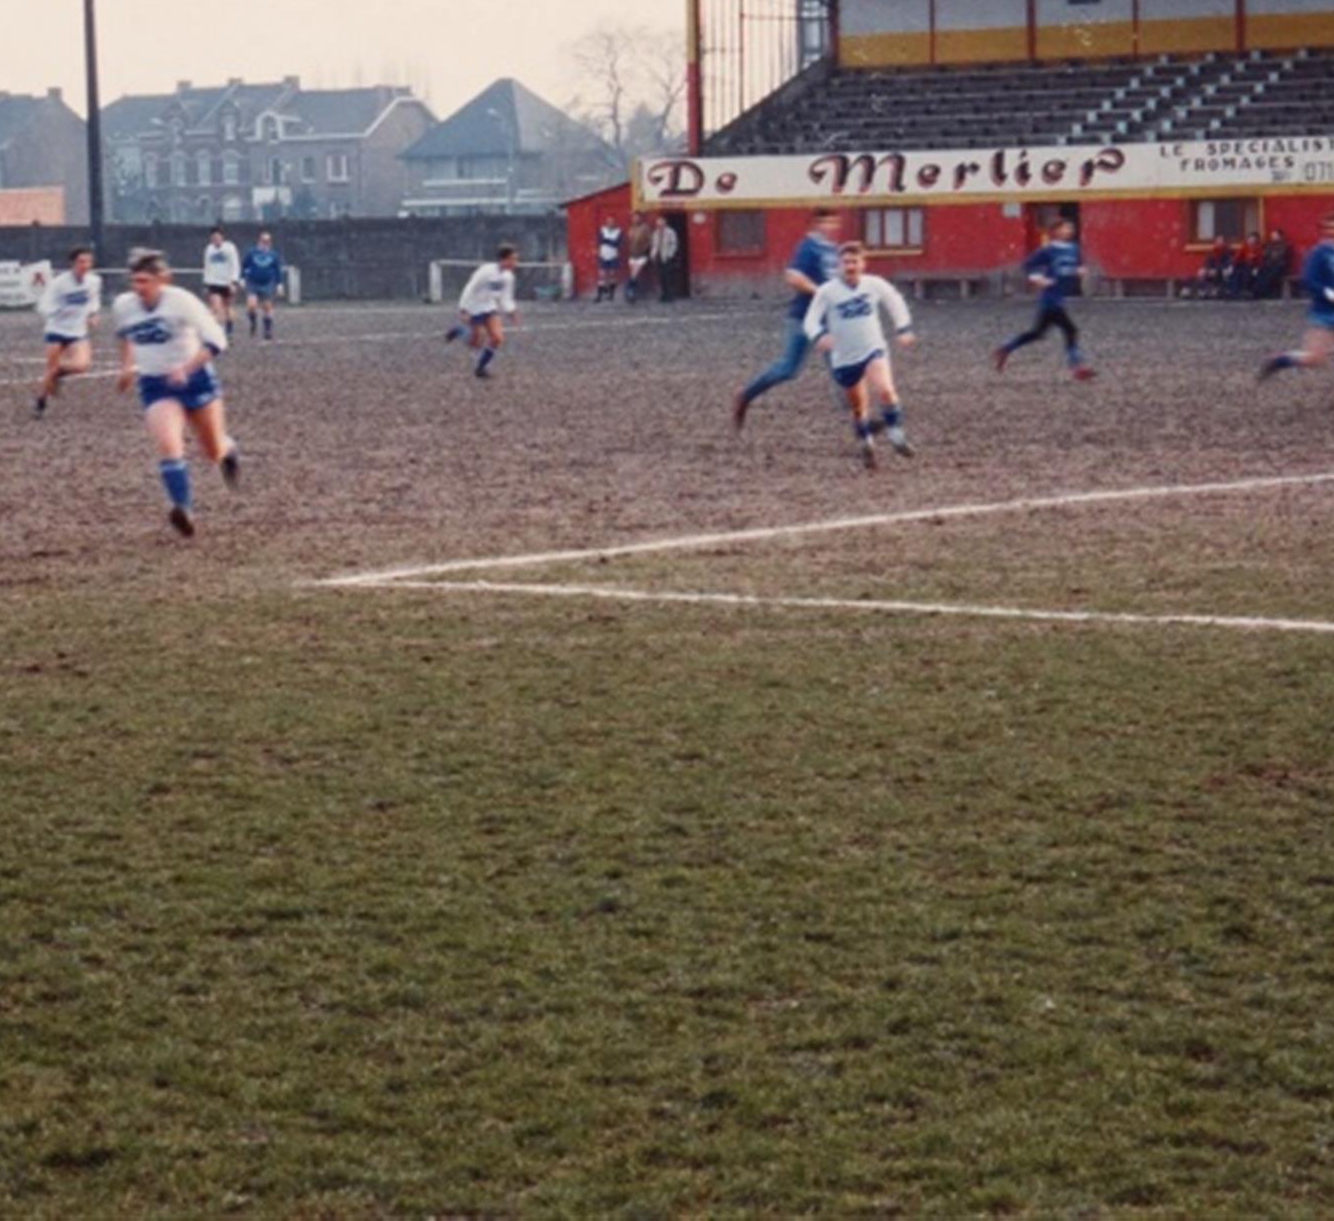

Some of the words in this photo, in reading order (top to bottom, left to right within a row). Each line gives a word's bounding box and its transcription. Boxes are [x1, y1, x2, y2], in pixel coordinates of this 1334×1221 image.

[1159, 144, 1183, 158] LE
[647, 160, 738, 197] De
[808, 147, 1126, 195] Merlier
[1180, 156, 1295, 172] FROMAGES
